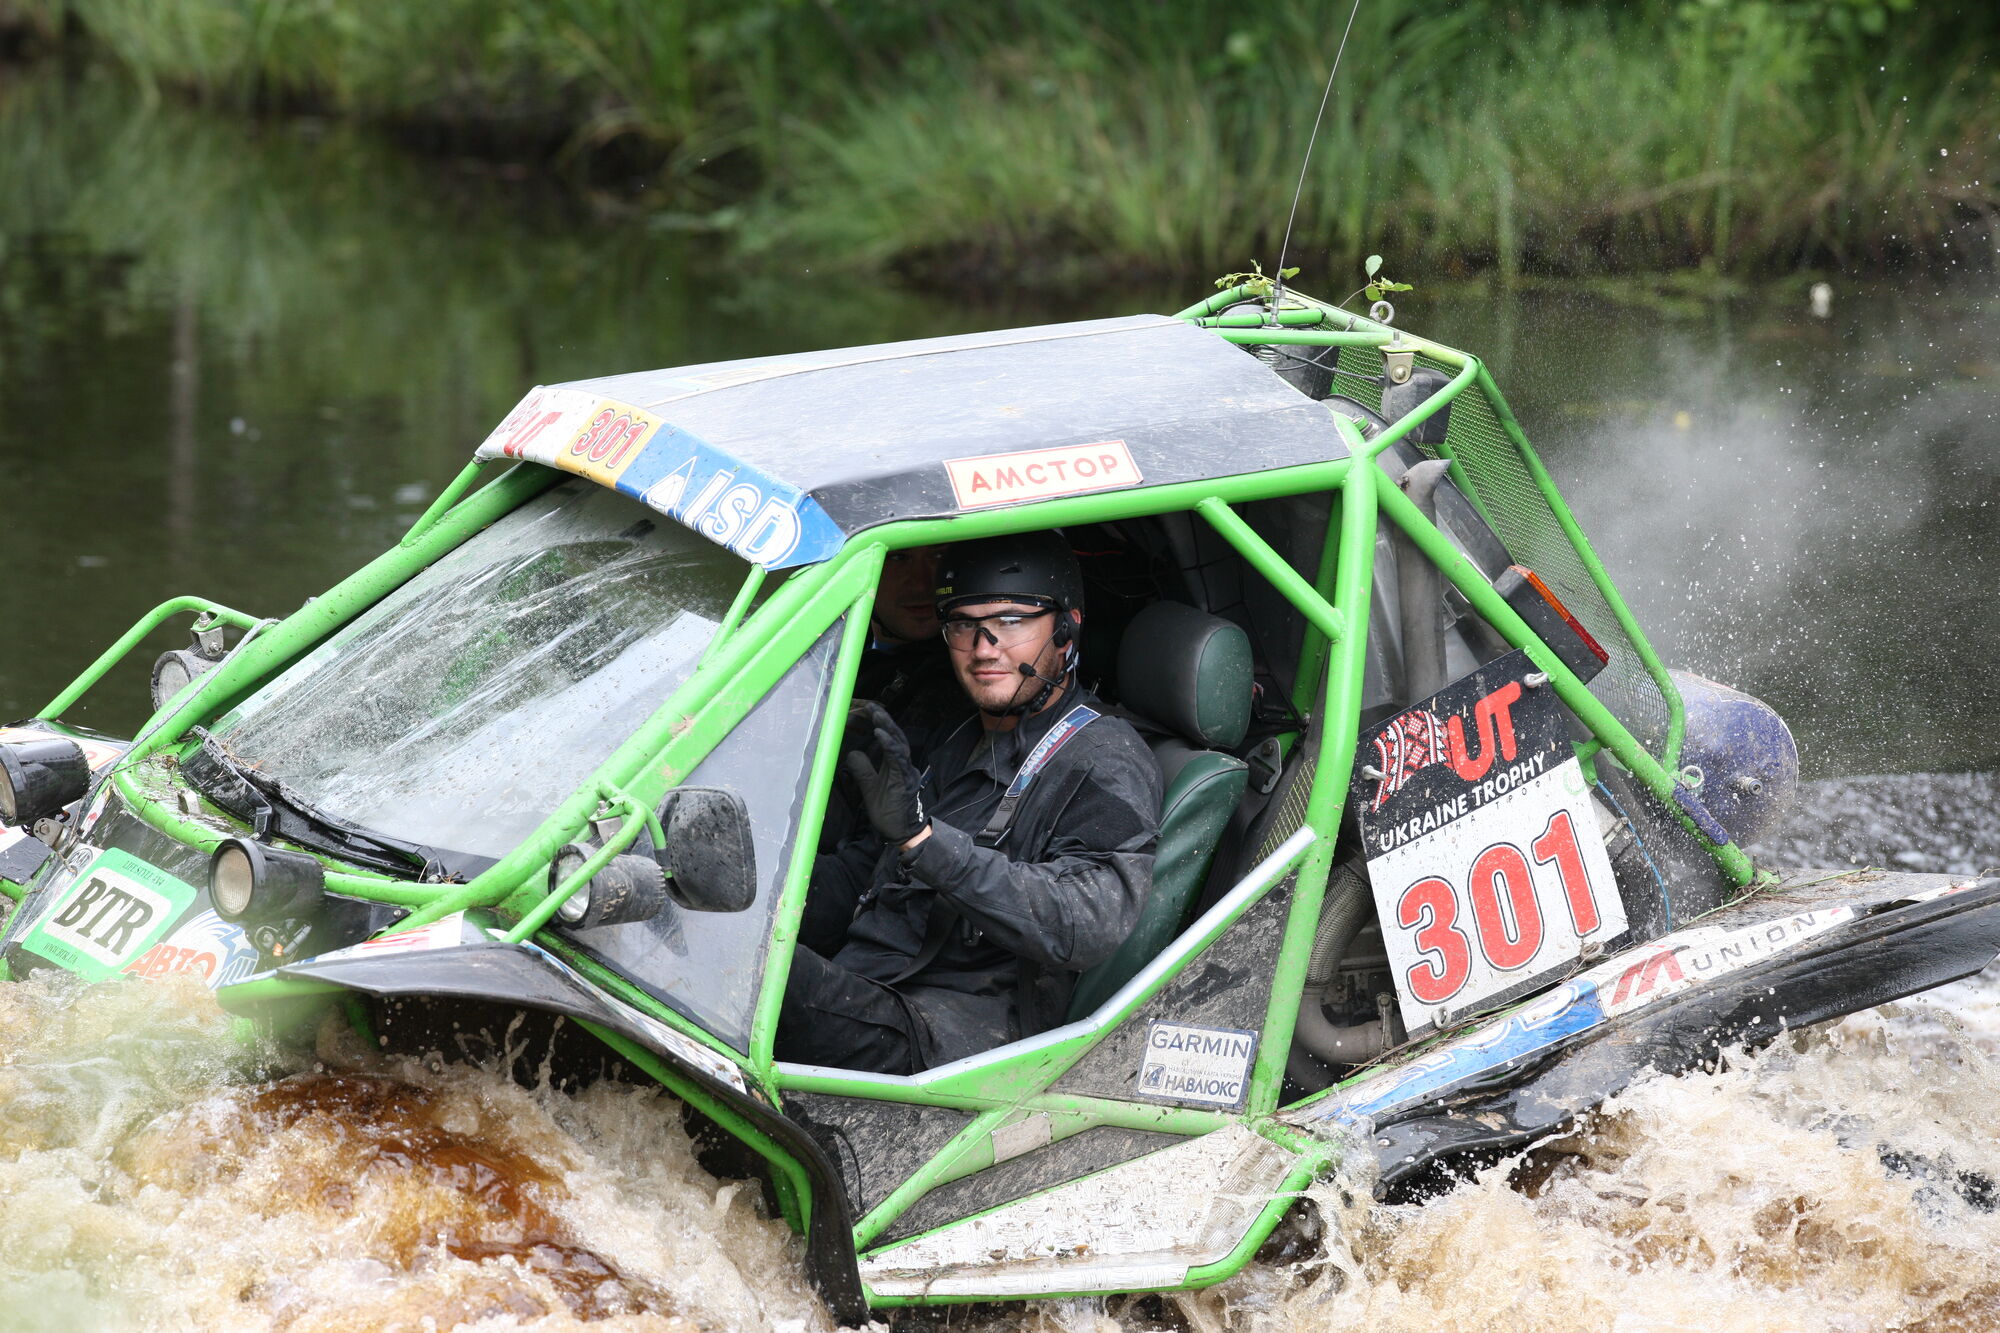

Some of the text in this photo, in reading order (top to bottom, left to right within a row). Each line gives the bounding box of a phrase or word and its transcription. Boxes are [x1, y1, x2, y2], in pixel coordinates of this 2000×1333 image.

[571, 408, 649, 469] 301
[1021, 720, 1073, 777] SANDTLER
[1448, 681, 1522, 781] UT
[1380, 751, 1546, 852] UKRAINE TROPHY
[53, 876, 154, 956] BTR
[1397, 808, 1602, 1005] 301
[1692, 912, 1816, 971] UNION
[1151, 1030, 1249, 1059] GARMIN
[1164, 1074, 1239, 1098] НАВЛЮКС
